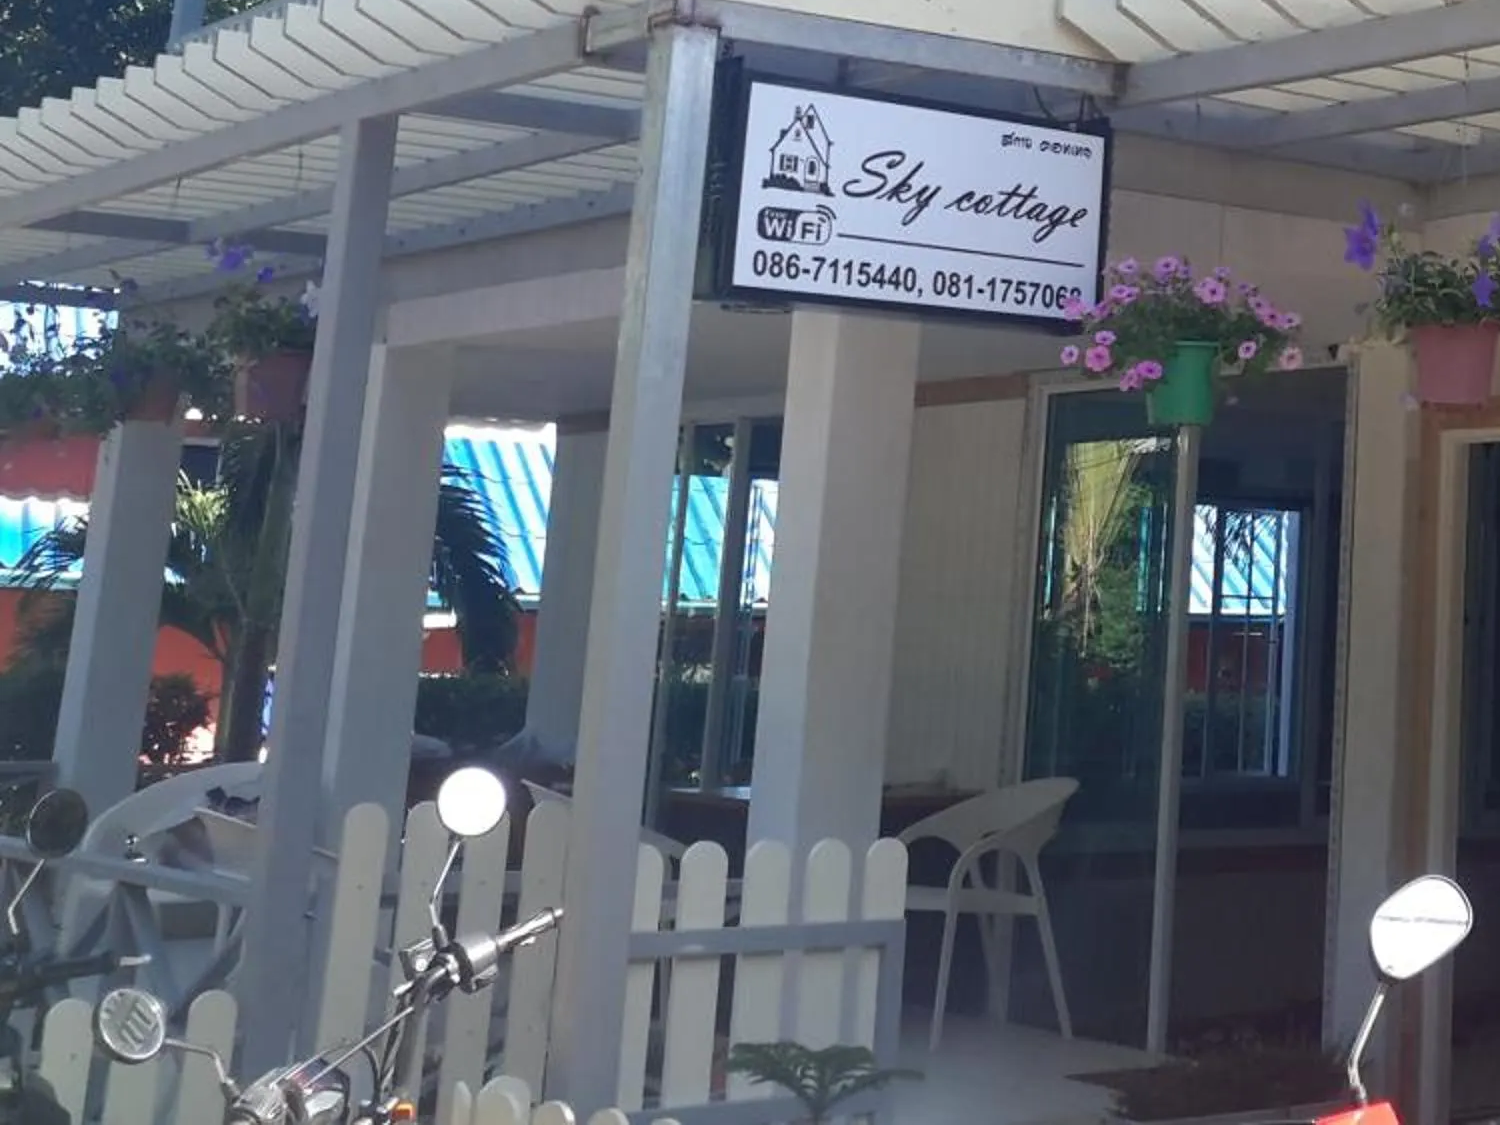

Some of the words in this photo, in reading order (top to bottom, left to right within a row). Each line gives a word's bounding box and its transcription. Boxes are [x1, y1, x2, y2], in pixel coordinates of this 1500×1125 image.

[843, 150, 942, 226] Sky
[944, 183, 1089, 244] cottage
[753, 250, 924, 297] 086-7115440,
